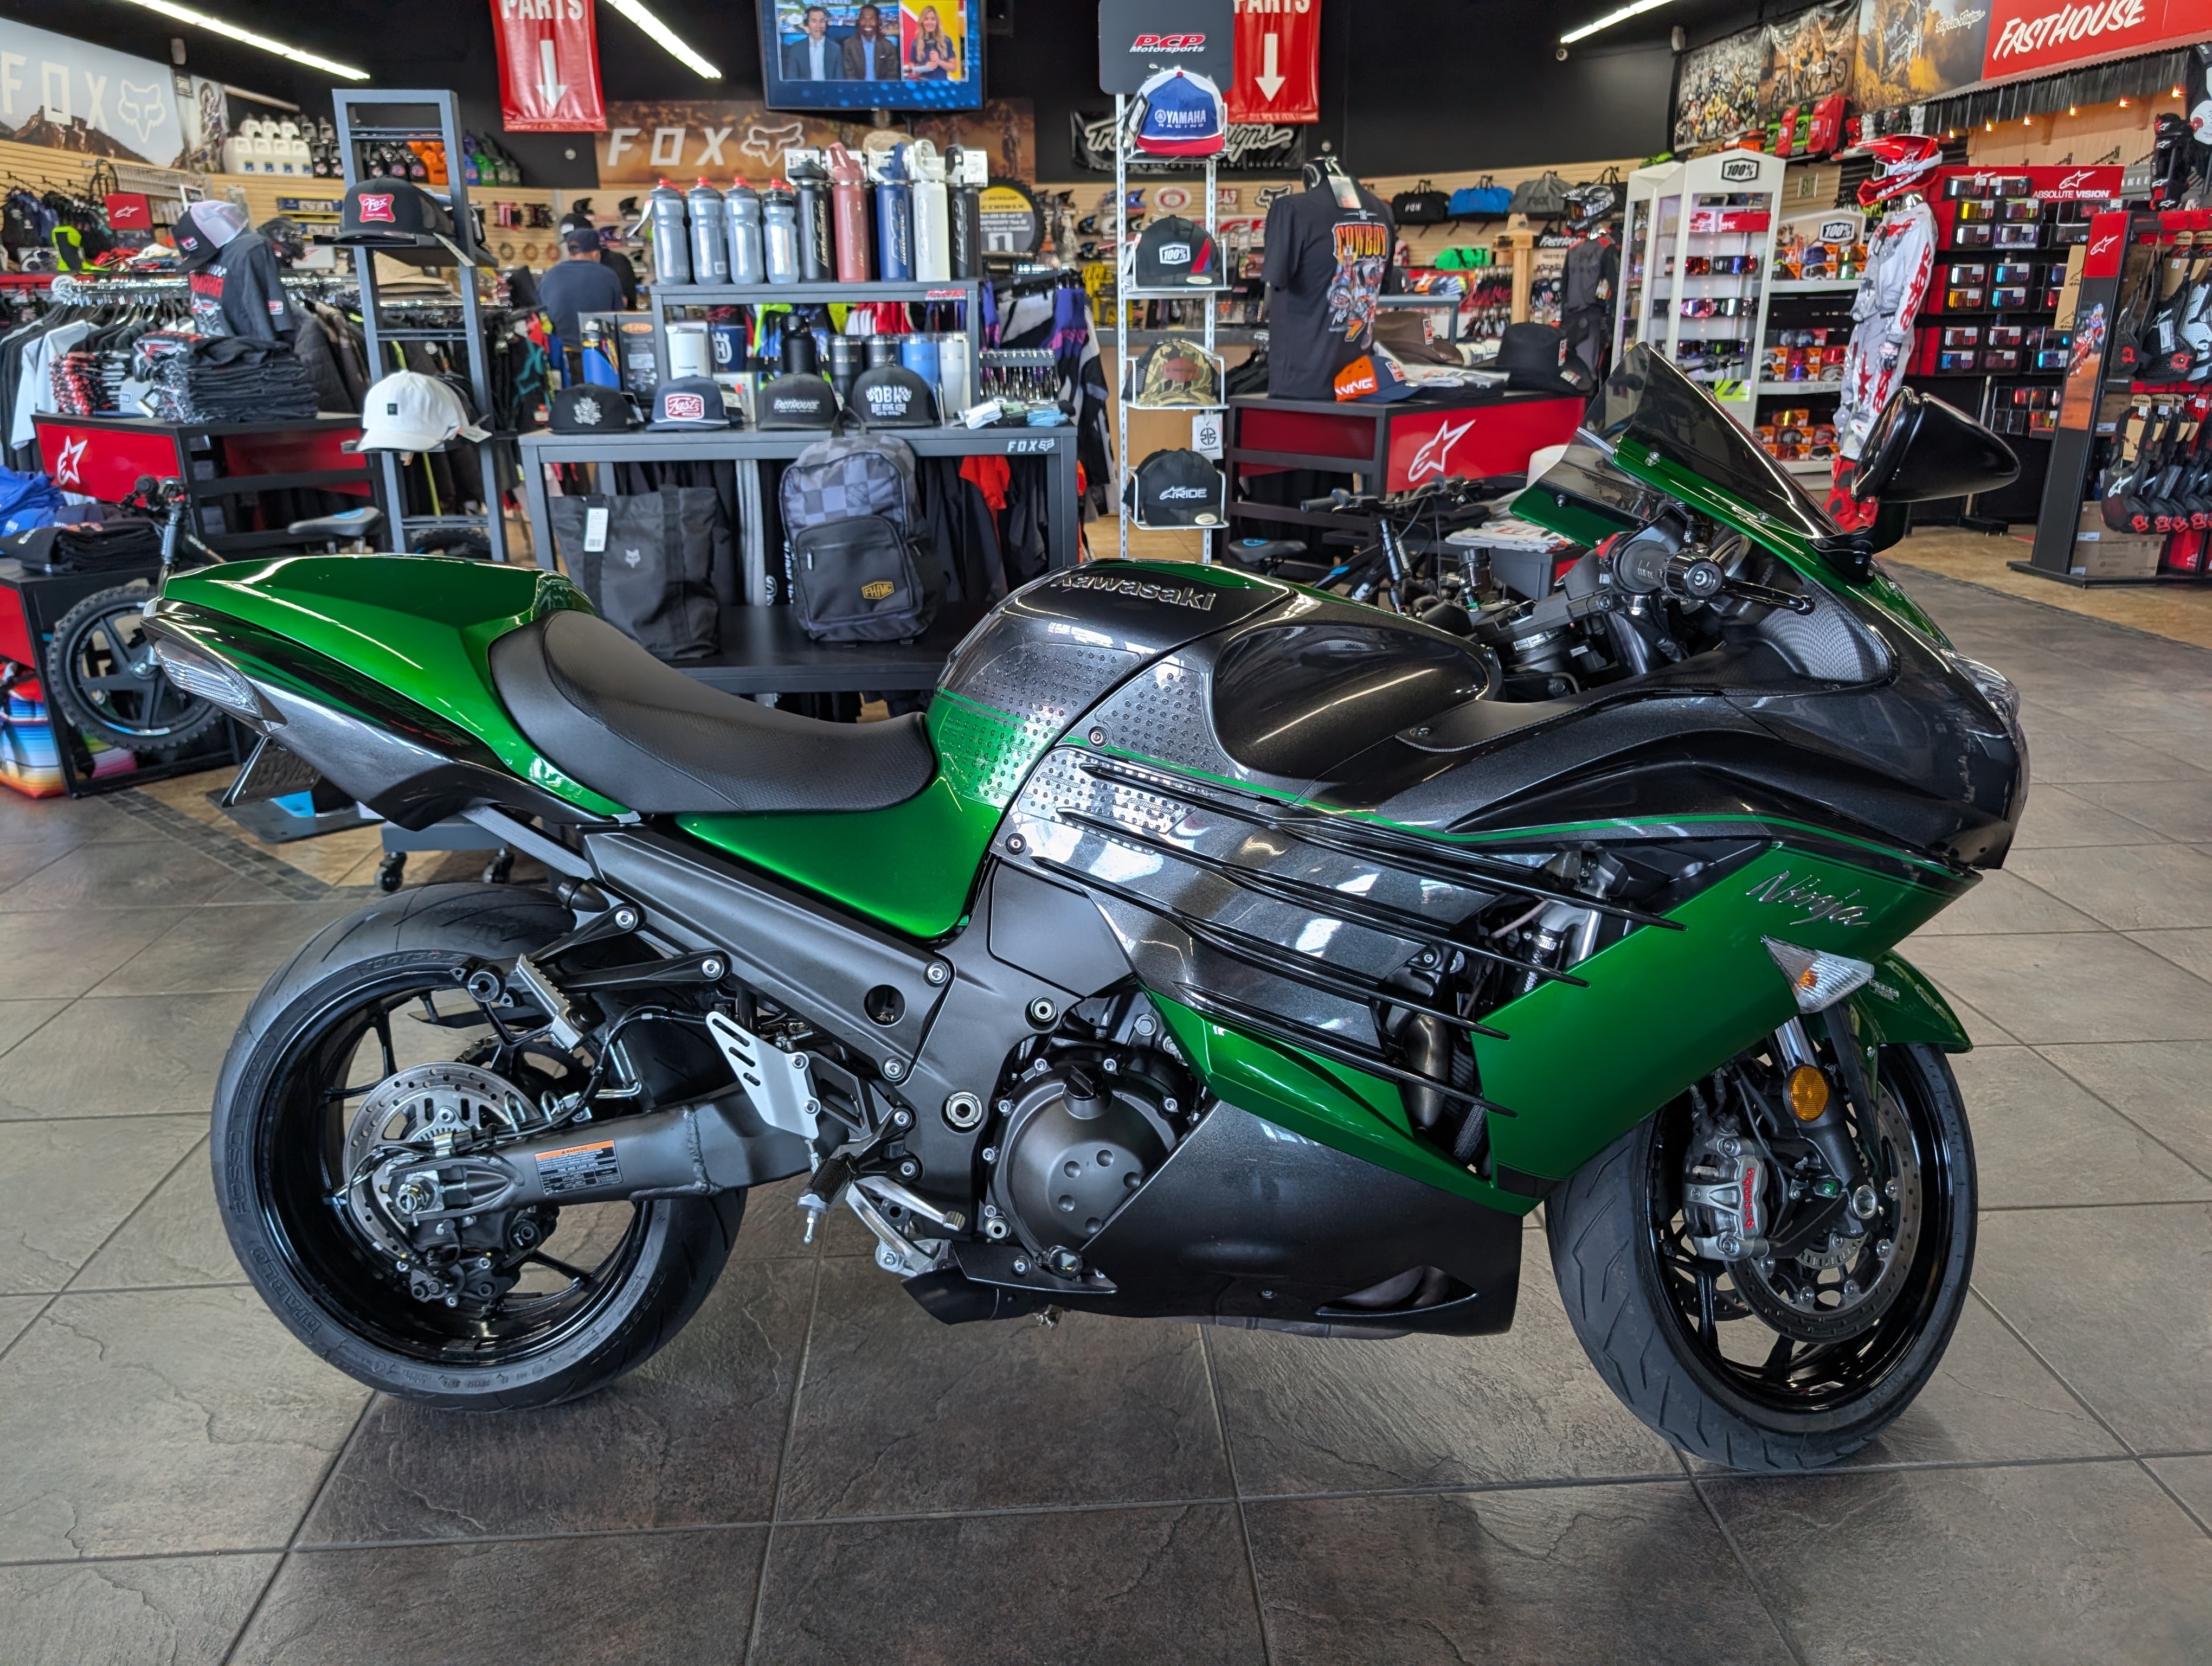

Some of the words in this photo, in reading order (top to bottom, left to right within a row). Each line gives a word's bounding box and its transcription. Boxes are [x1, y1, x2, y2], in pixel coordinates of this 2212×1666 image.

[501, 0, 584, 20] PARTS
[1993, 0, 2144, 61] FASTHOUSE
[1133, 34, 1206, 48] PCP
[1, 51, 109, 133] FOX
[1167, 110, 1206, 124] YAMAHA
[608, 127, 733, 166] FOX
[1726, 163, 1754, 177] 100%
[2033, 190, 2074, 199] ABSOLUTE
[2076, 190, 2110, 198] VISION
[363, 197, 387, 210] Fox
[1824, 223, 1853, 239] 100%
[1335, 225, 1387, 257] COWBOY
[1163, 249, 1187, 261] 100%
[774, 398, 820, 411] FASTHOUSE
[1007, 439, 1037, 453] FOX
[1746, 870, 1870, 927] Ninja
[1742, 1168, 1755, 1229] brembo
[251, 1246, 322, 1334] DIABLO
